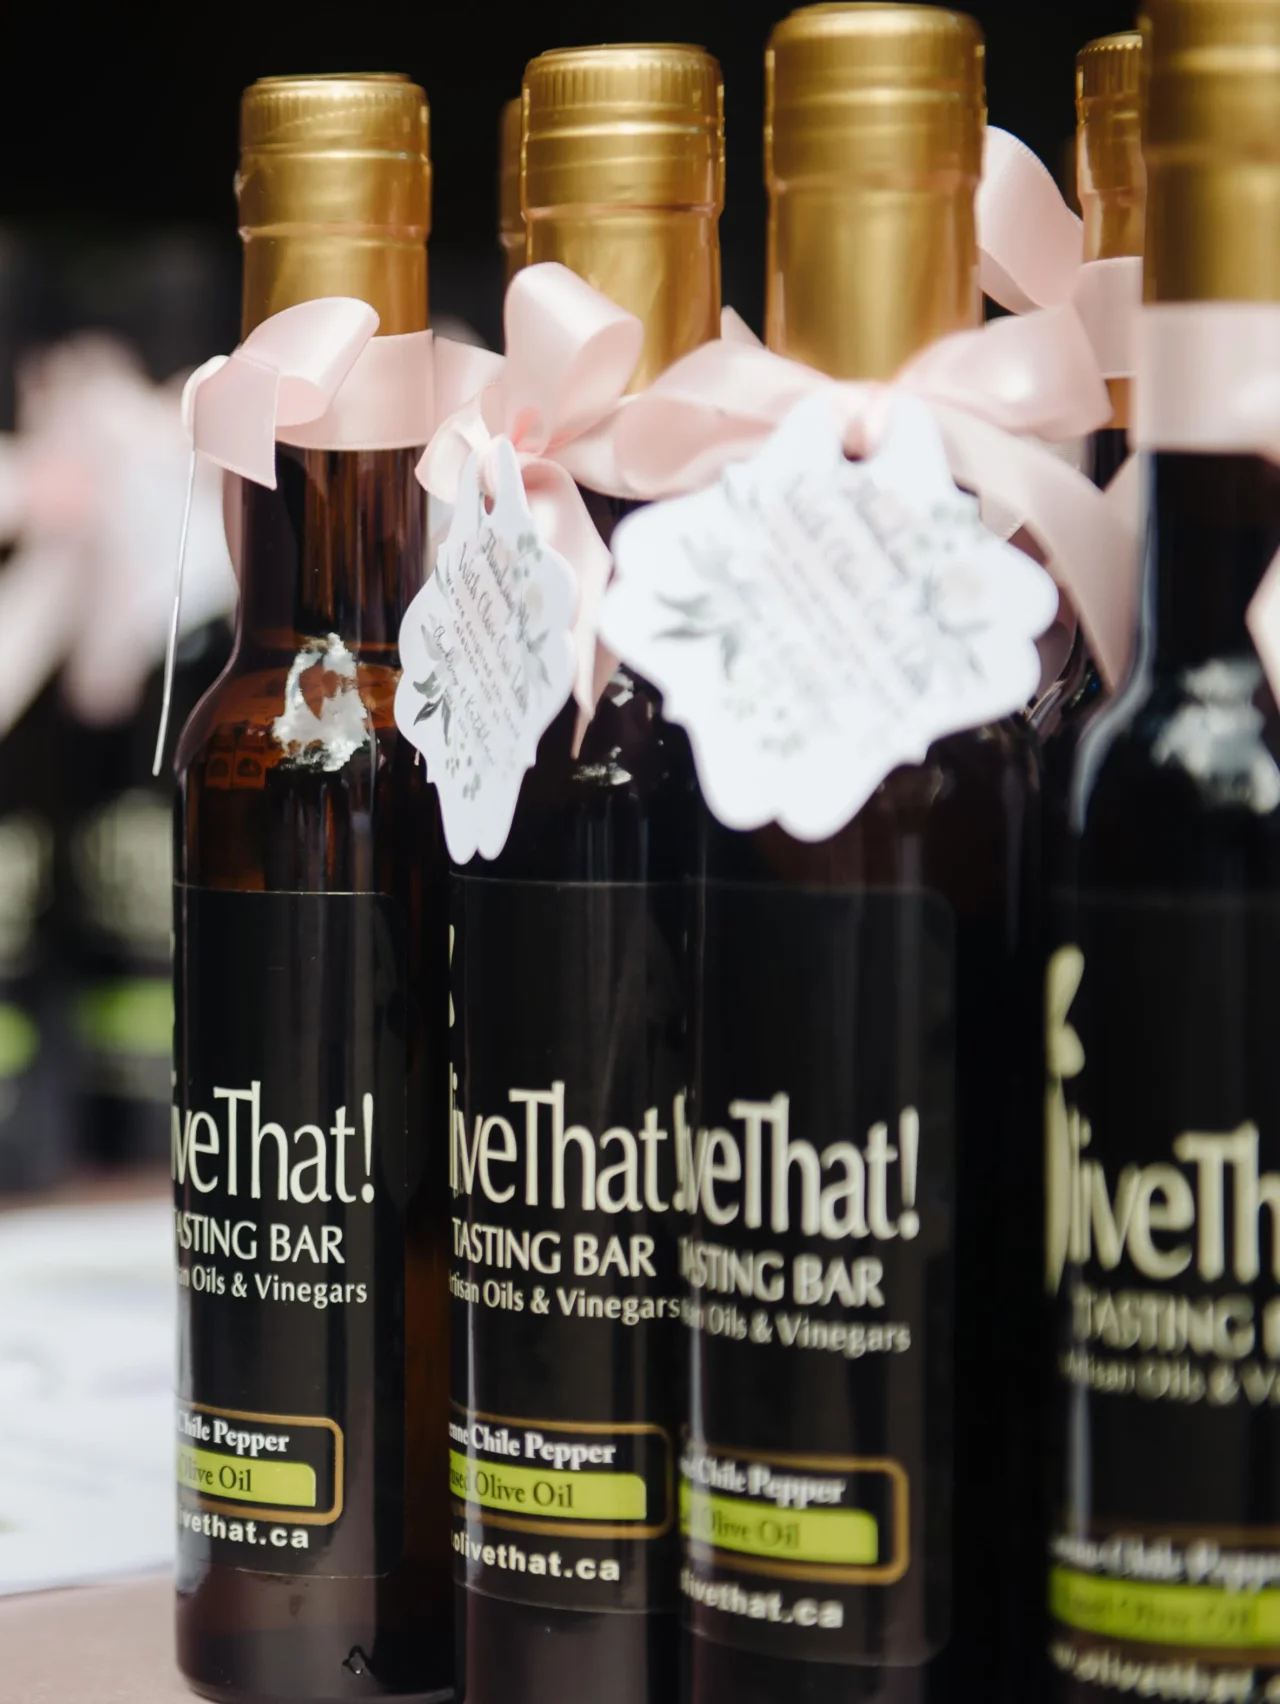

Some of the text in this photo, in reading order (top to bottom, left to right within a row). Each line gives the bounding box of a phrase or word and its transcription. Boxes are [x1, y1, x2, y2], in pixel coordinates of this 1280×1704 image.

[174, 1208, 346, 1264] ASTING BAR
[451, 1216, 657, 1277] TASTING BAR
[192, 1265, 226, 1295] Oils
[231, 1271, 248, 1298] &
[253, 1272, 368, 1310] Vinegars
[483, 1279, 525, 1312] Oils
[530, 1284, 550, 1315] &
[556, 1285, 681, 1326] Vinegars
[792, 1252, 885, 1308] BAR
[706, 1302, 748, 1340] Oils
[749, 1307, 773, 1344] &
[775, 1309, 911, 1359] Vinegars
[1071, 1284, 1256, 1361] TASTING
[213, 1418, 290, 1457] Pepper
[471, 1423, 521, 1457] Chile
[524, 1431, 617, 1471] Pepper
[219, 1465, 252, 1492] Oil
[475, 1470, 527, 1504] Olive
[532, 1480, 575, 1509] Oil
[695, 1455, 747, 1493] Chile
[747, 1462, 847, 1510] Pepper
[757, 1517, 801, 1549] Oil
